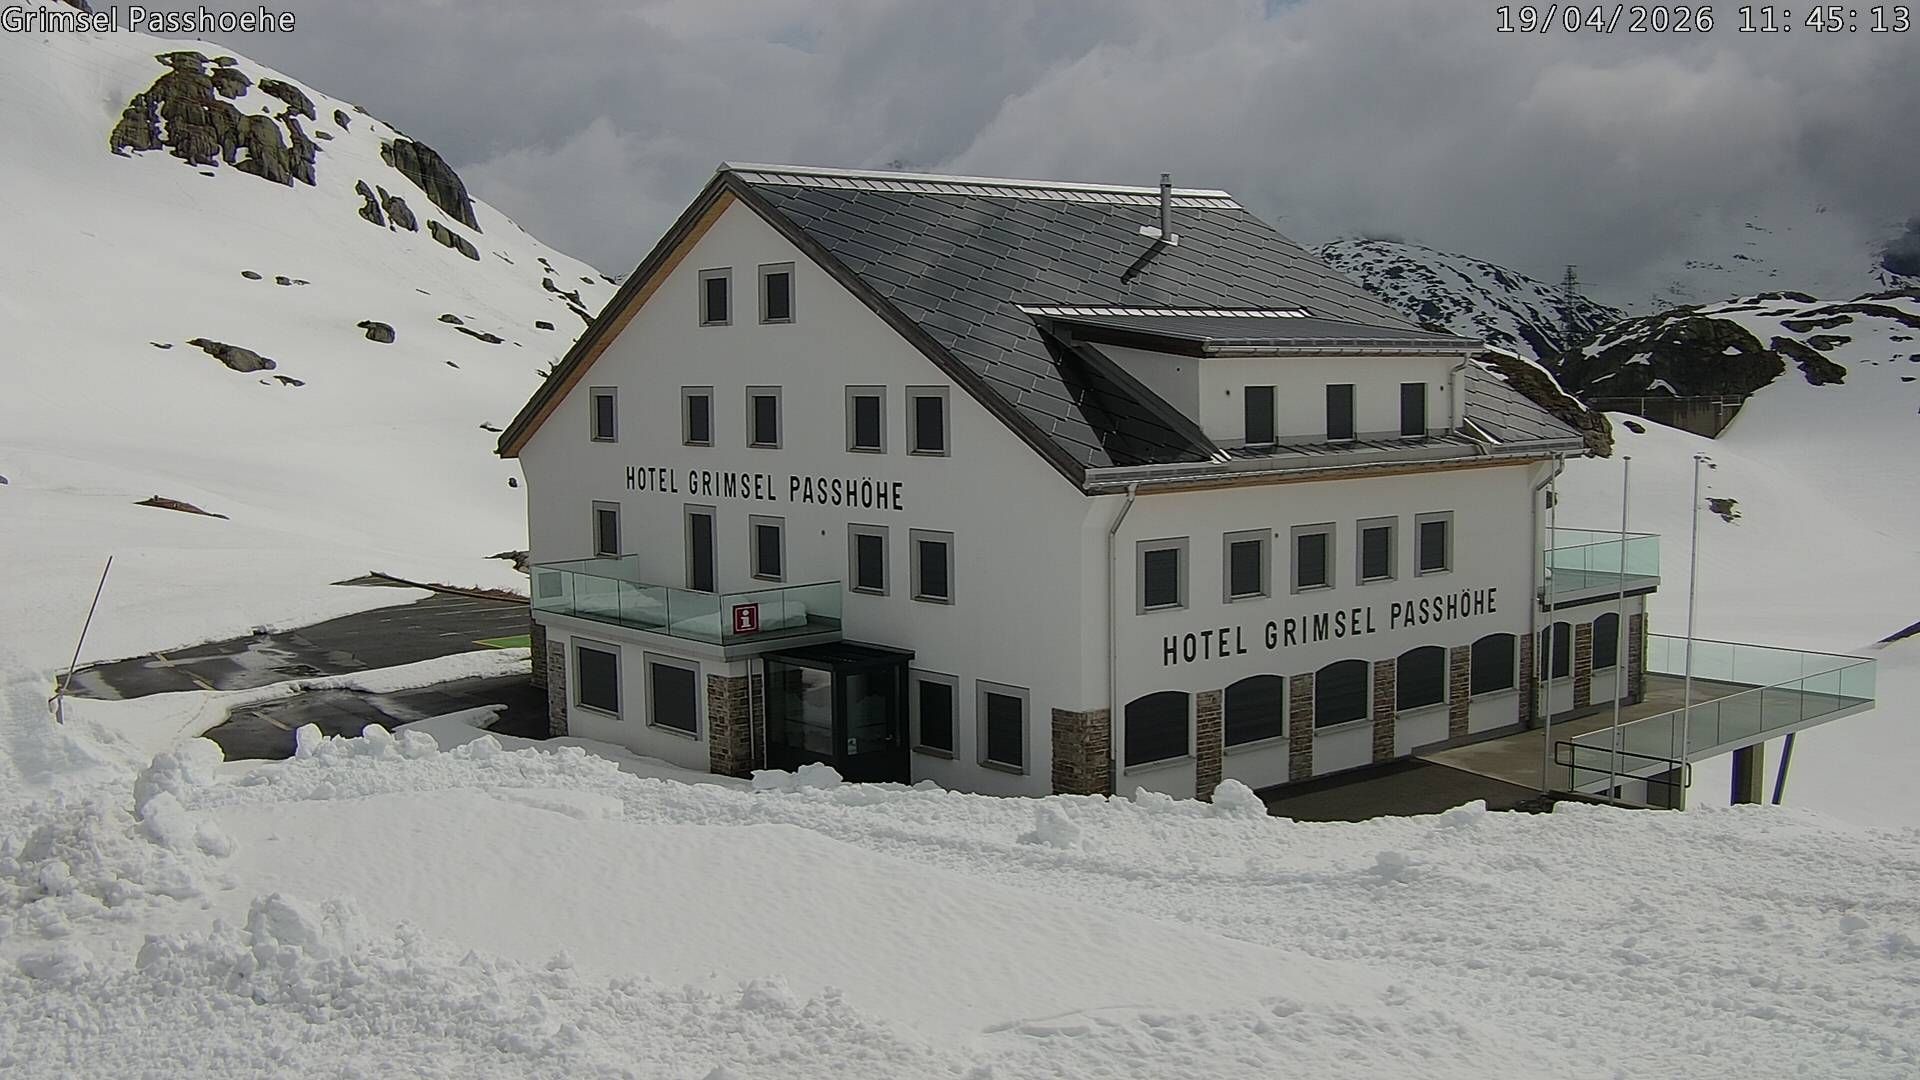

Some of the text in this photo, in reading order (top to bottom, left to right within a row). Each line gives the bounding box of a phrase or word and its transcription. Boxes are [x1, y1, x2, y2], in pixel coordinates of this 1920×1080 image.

[626, 466, 904, 511] HOTEL GRIMSEL PASSHÖHE
[1163, 587, 1498, 666] HOTEL GRIMSEL PASSHÖHE
